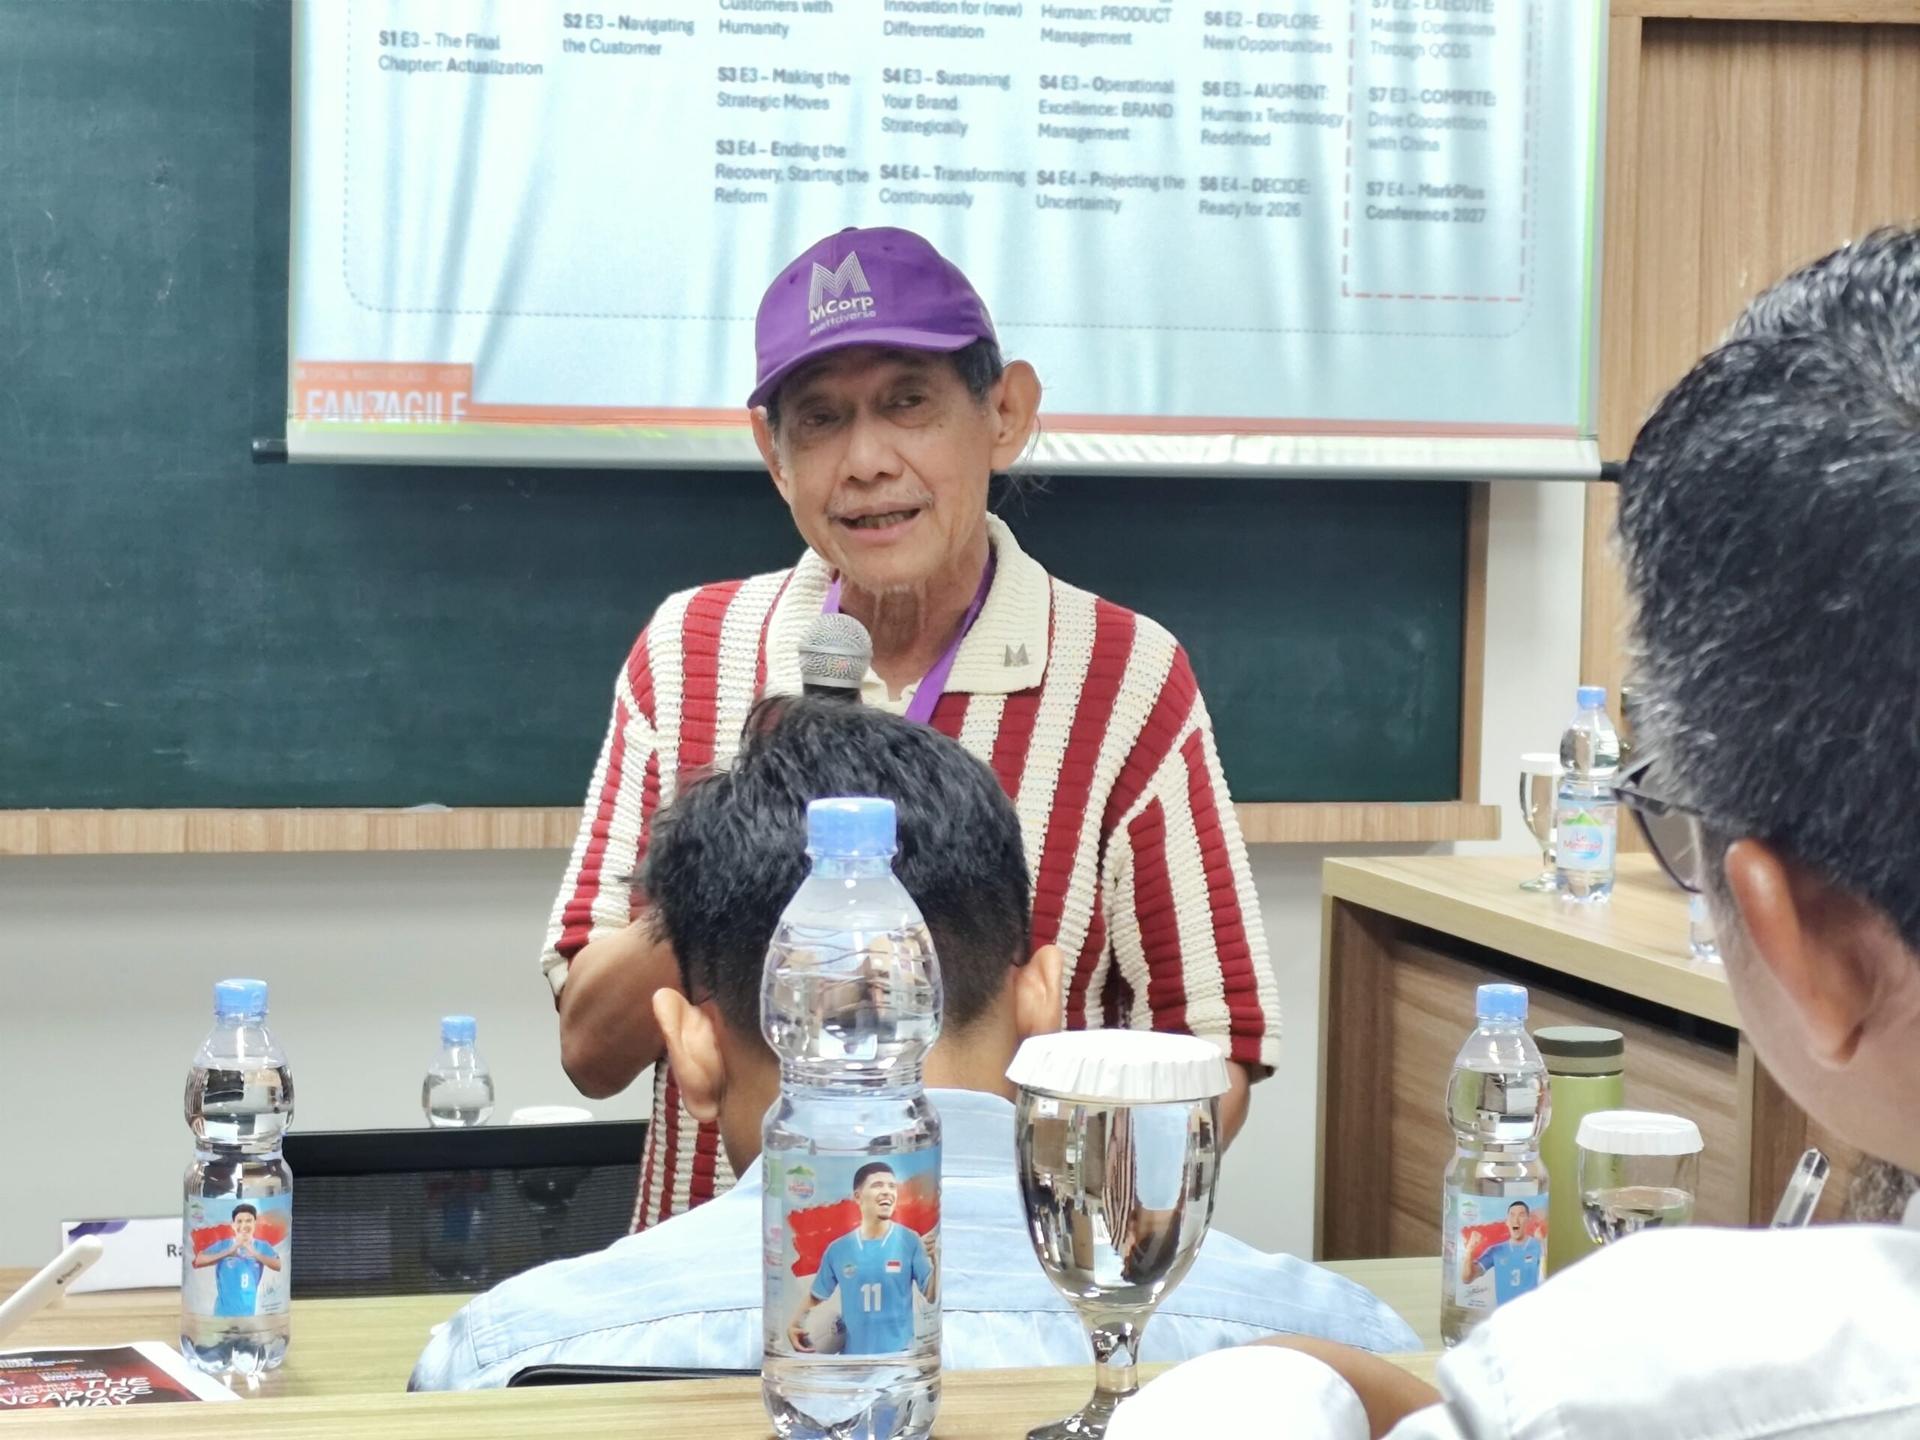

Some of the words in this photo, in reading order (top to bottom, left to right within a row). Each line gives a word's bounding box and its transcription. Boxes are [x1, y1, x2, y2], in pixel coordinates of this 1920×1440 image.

[720, 0, 798, 11] Customers
[803, 0, 833, 13] with
[884, 0, 958, 14] Innovation
[961, 1, 980, 15] for
[984, 3, 1022, 17] (new)
[1041, 4, 1097, 20] Human:
[1101, 5, 1172, 23] PRODUCT
[563, 13, 582, 28] S2
[586, 14, 603, 29] E3
[619, 15, 694, 35] Navigating
[1226, 11, 1243, 27] E2
[719, 19, 789, 39] Humanity
[883, 20, 985, 38] Differentiation
[1040, 27, 1133, 47] Management
[379, 31, 397, 46] S1
[401, 32, 419, 47] E3
[435, 33, 462, 48] The
[466, 34, 500, 50] Final
[563, 38, 585, 53] the
[590, 39, 662, 55] Customer
[1203, 35, 1235, 50] New
[1238, 35, 1332, 53] Opportunities
[379, 55, 442, 74] Chapter:
[447, 57, 543, 75] Actualization
[718, 67, 736, 82] S3
[740, 67, 758, 82] E3
[772, 68, 824, 89] Making
[827, 71, 851, 85] the
[883, 68, 900, 82] S4
[904, 68, 922, 84] E3
[936, 69, 1011, 90] Sustaining
[1061, 75, 1078, 91] E3
[1092, 76, 1175, 94] Operational
[717, 91, 780, 111] Strategic
[784, 93, 829, 110] Moves
[882, 93, 912, 109] Your
[916, 94, 958, 110] Brand
[1122, 101, 1173, 118] BRAND
[881, 116, 968, 138] Strategically
[1201, 107, 1252, 122] Human
[1266, 108, 1344, 128] Technology
[1038, 123, 1130, 143] Management
[1201, 129, 1271, 146] Redefined
[716, 140, 734, 155] S3
[738, 140, 755, 155] E4
[771, 140, 820, 161] Ending
[822, 145, 846, 158] the
[1368, 136, 1396, 150] with
[1400, 136, 1440, 151] China
[788, 166, 843, 186] Starting
[846, 169, 869, 183] the
[880, 164, 898, 179] S4
[902, 165, 919, 180] E4
[934, 165, 1026, 187] Transforming
[1059, 170, 1076, 186] E4
[1090, 171, 1160, 192] Projecting
[1163, 176, 1185, 190] the
[1221, 177, 1239, 192] E4
[715, 187, 767, 203] Reform
[879, 187, 974, 209] Continuously
[1418, 184, 1485, 200] MarkPlus
[1199, 200, 1242, 218] Ready
[1245, 202, 1263, 216] for
[1366, 205, 1449, 221] Conference
[809, 296, 874, 324] MCorp
[241, 1273, 249, 1289] 8
[1510, 1269, 1521, 1286] 3
[860, 1283, 881, 1312] 11
[83, 1376, 149, 1389] THE
